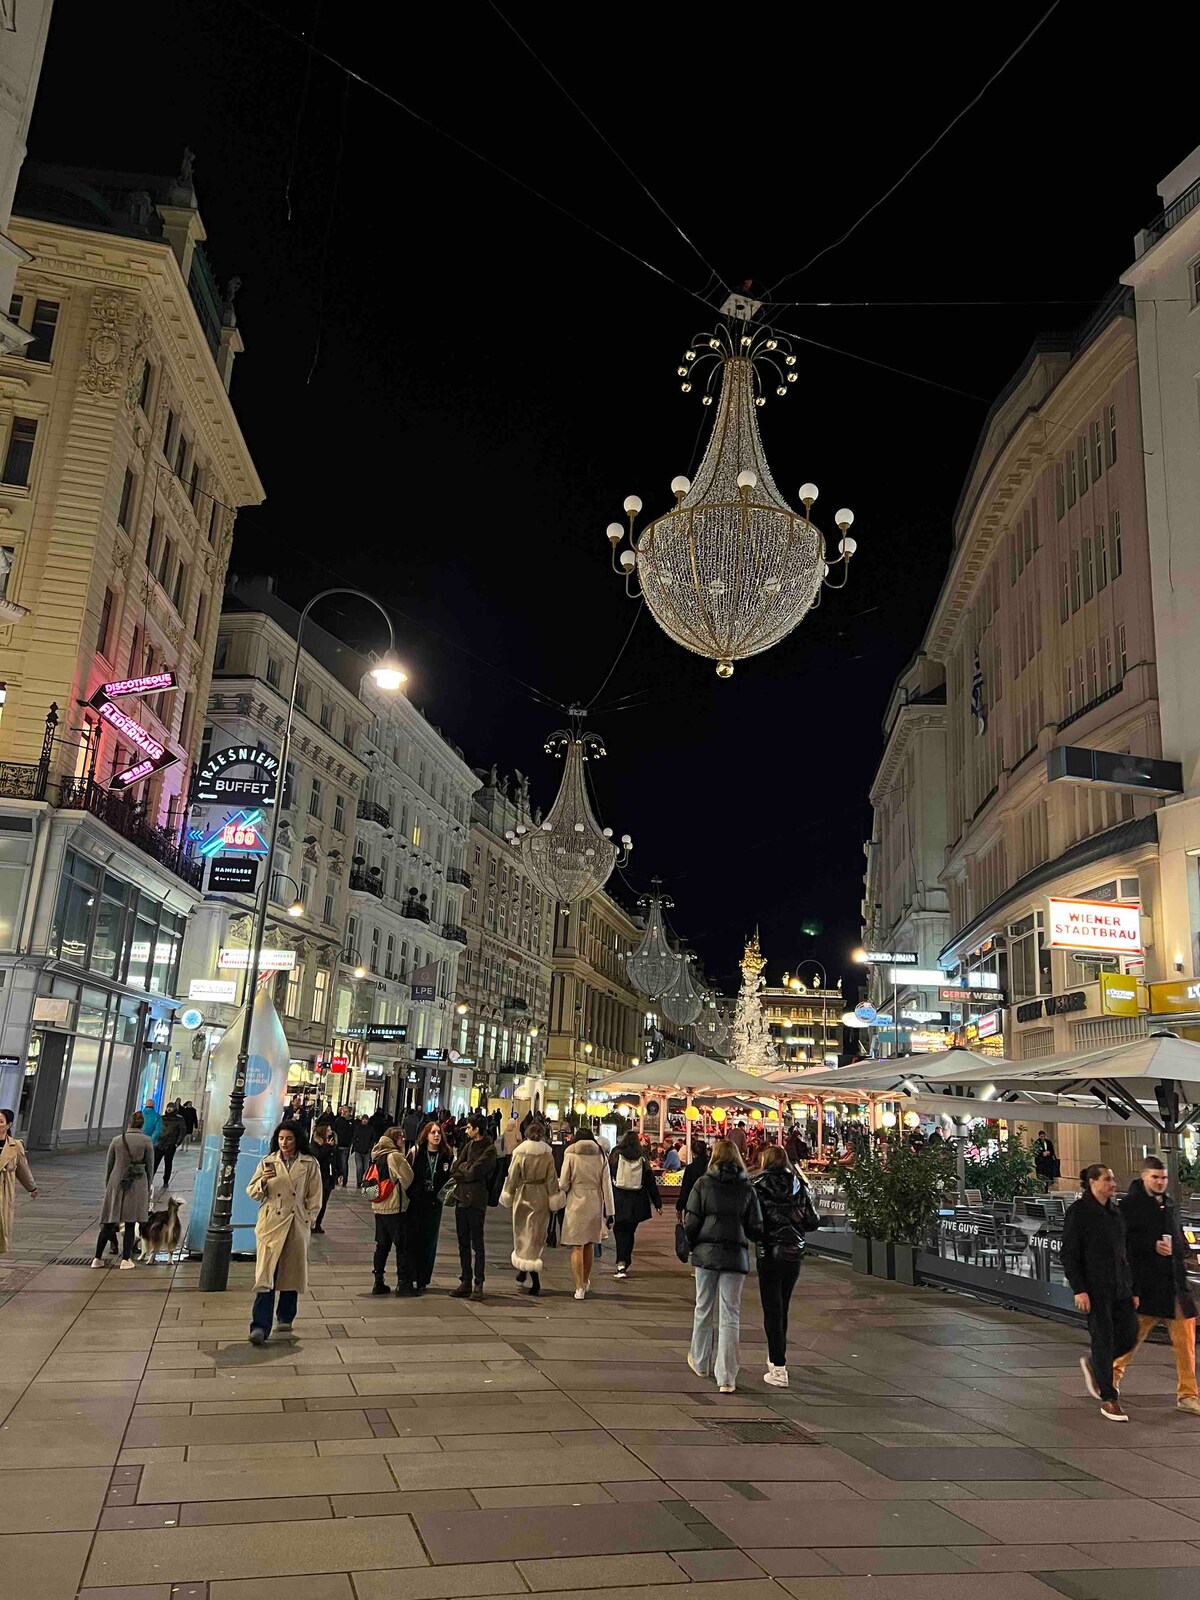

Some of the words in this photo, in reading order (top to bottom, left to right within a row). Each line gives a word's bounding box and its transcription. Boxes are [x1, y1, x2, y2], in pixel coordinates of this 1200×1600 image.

[105, 673, 172, 692] DISCOTHEQUE
[98, 703, 164, 760] FLEDERMAUS
[132, 760, 152, 777] BAR
[215, 780, 269, 795] BUFFET
[1069, 911, 1121, 927] WIENER
[415, 986, 433, 995] LPE
[942, 990, 972, 999] GERRY
[973, 991, 1004, 1001] WEBER
[819, 1199, 831, 1208] FIVE
[831, 1200, 846, 1211] GUYS
[941, 1220, 957, 1231] FIVE
[958, 1222, 979, 1235] GUYS
[1029, 1236, 1048, 1249] FIVE
[1050, 1239, 1063, 1251] GU
